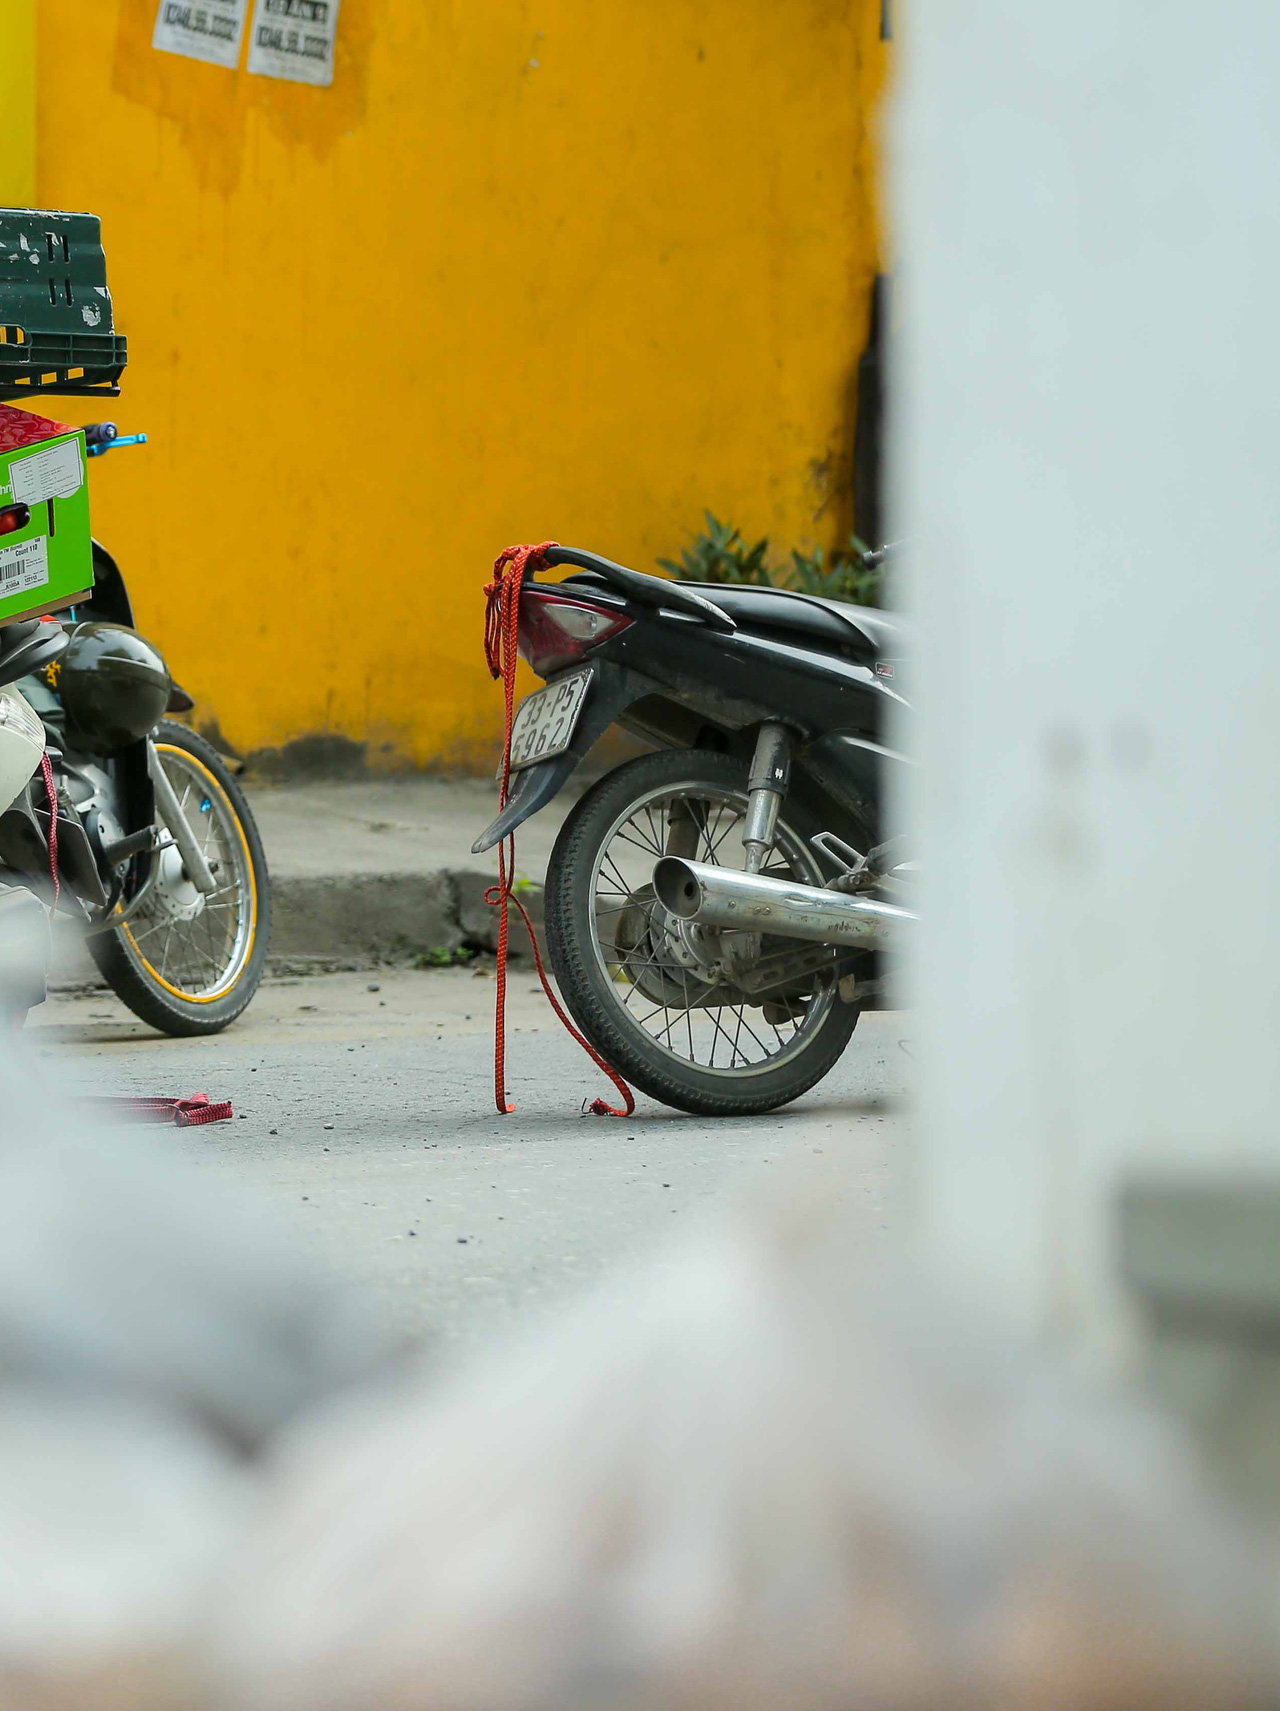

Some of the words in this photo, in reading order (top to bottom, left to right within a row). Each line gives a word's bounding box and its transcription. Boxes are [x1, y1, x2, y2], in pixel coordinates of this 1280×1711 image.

[15, 547, 29, 557] Count
[521, 678, 580, 730] 33-P5
[512, 716, 564, 762] 5962
